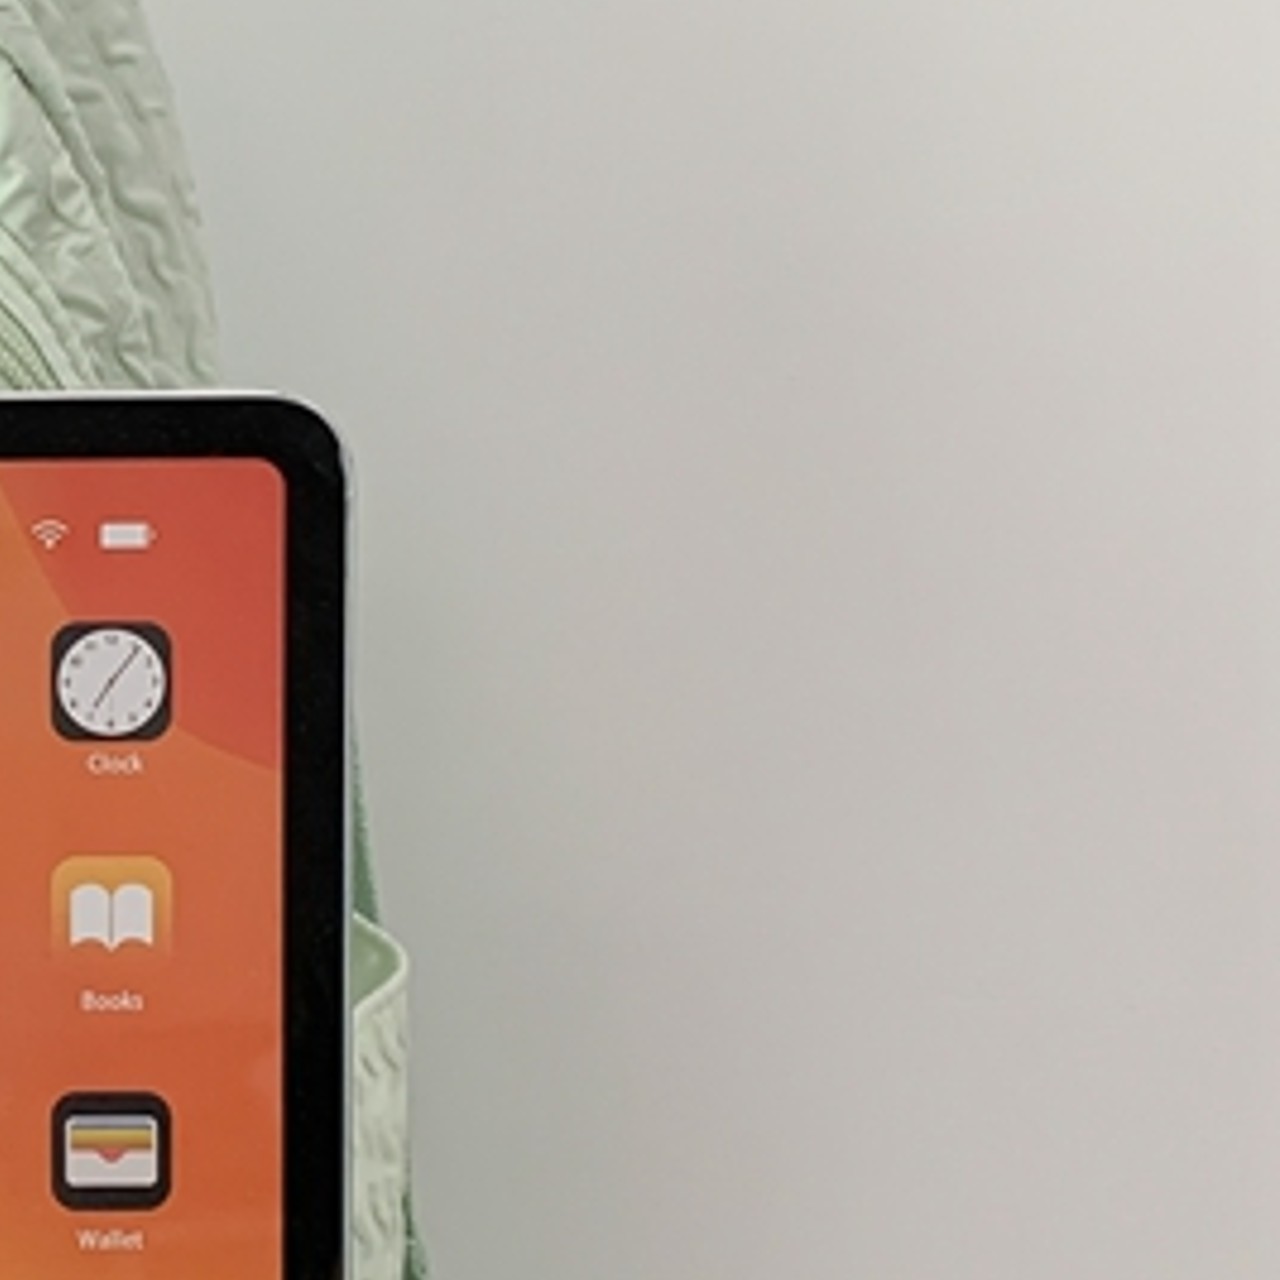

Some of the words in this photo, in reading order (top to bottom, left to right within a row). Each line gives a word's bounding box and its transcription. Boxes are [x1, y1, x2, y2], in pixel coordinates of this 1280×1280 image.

[86, 752, 143, 775] Clock
[80, 989, 144, 1012] Books
[76, 1228, 144, 1251] Wallet
